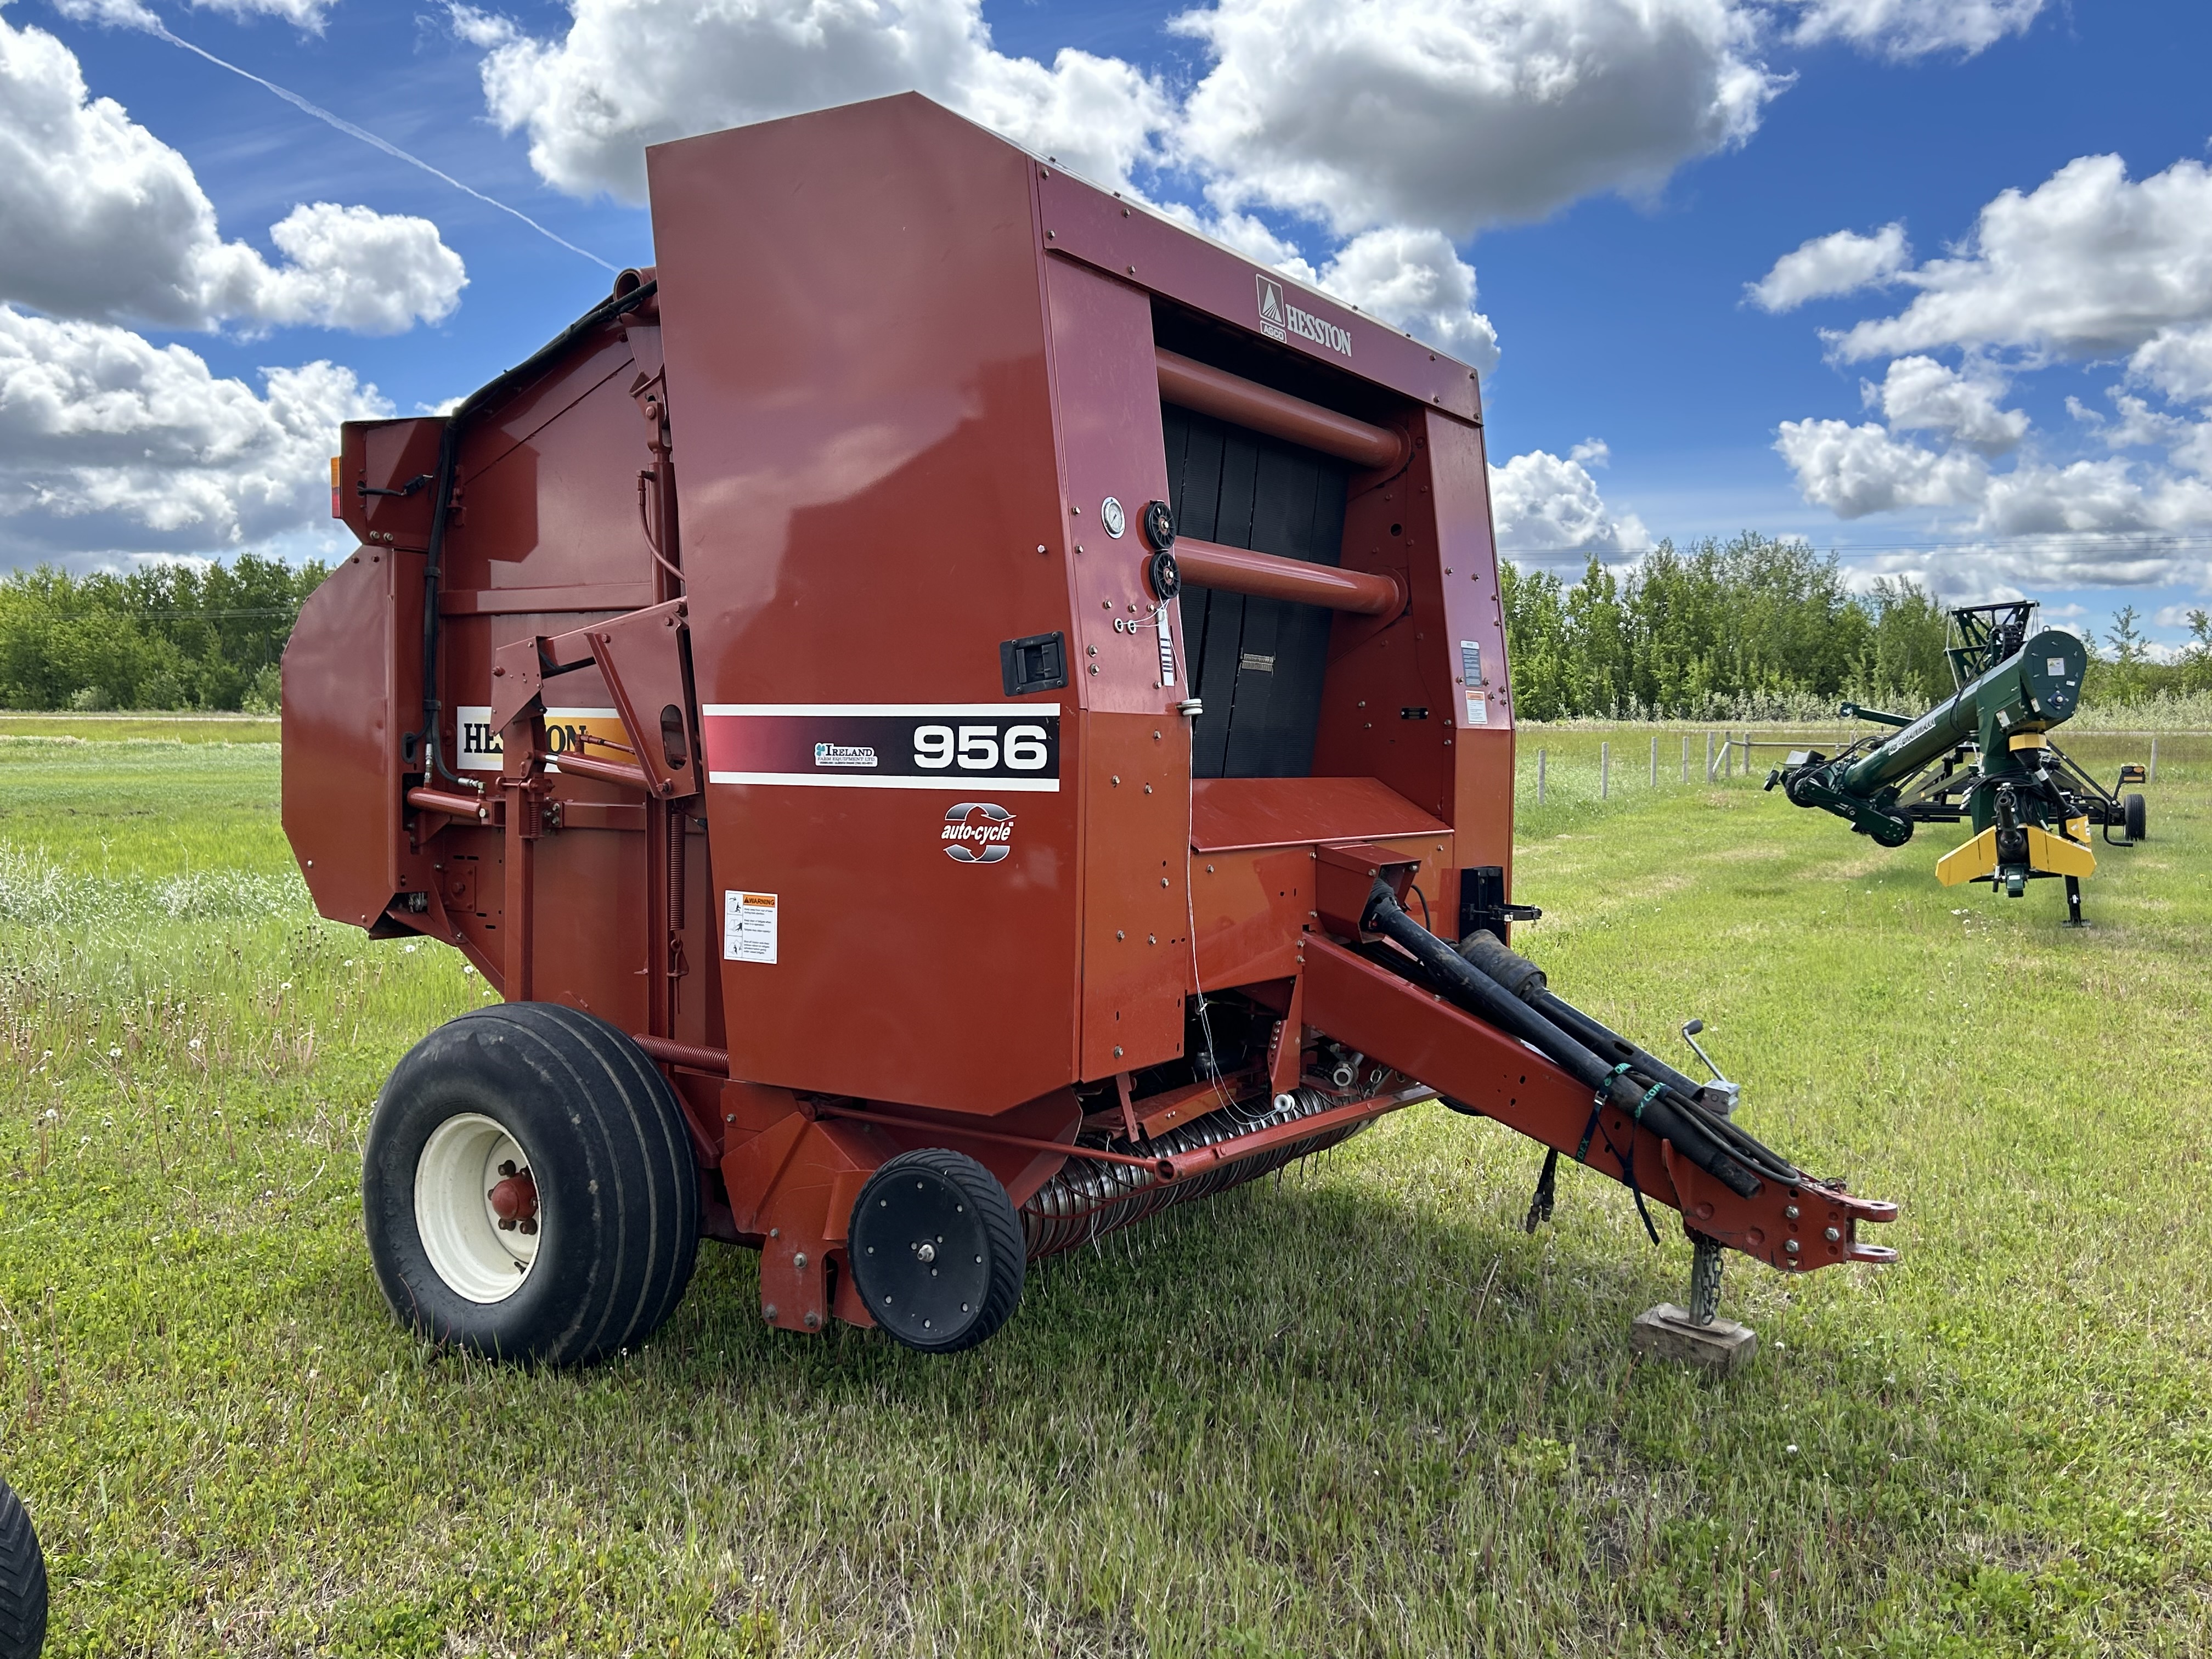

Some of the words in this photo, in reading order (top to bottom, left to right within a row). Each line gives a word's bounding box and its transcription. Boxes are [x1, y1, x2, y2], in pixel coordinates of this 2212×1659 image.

[1263, 325, 1284, 340] AGCO
[1285, 303, 1352, 357] HESSTON
[826, 744, 872, 757] IRELAND
[914, 725, 1047, 769] 956
[941, 822, 1011, 845] auto-cycle
[749, 898, 775, 906] WARNING
